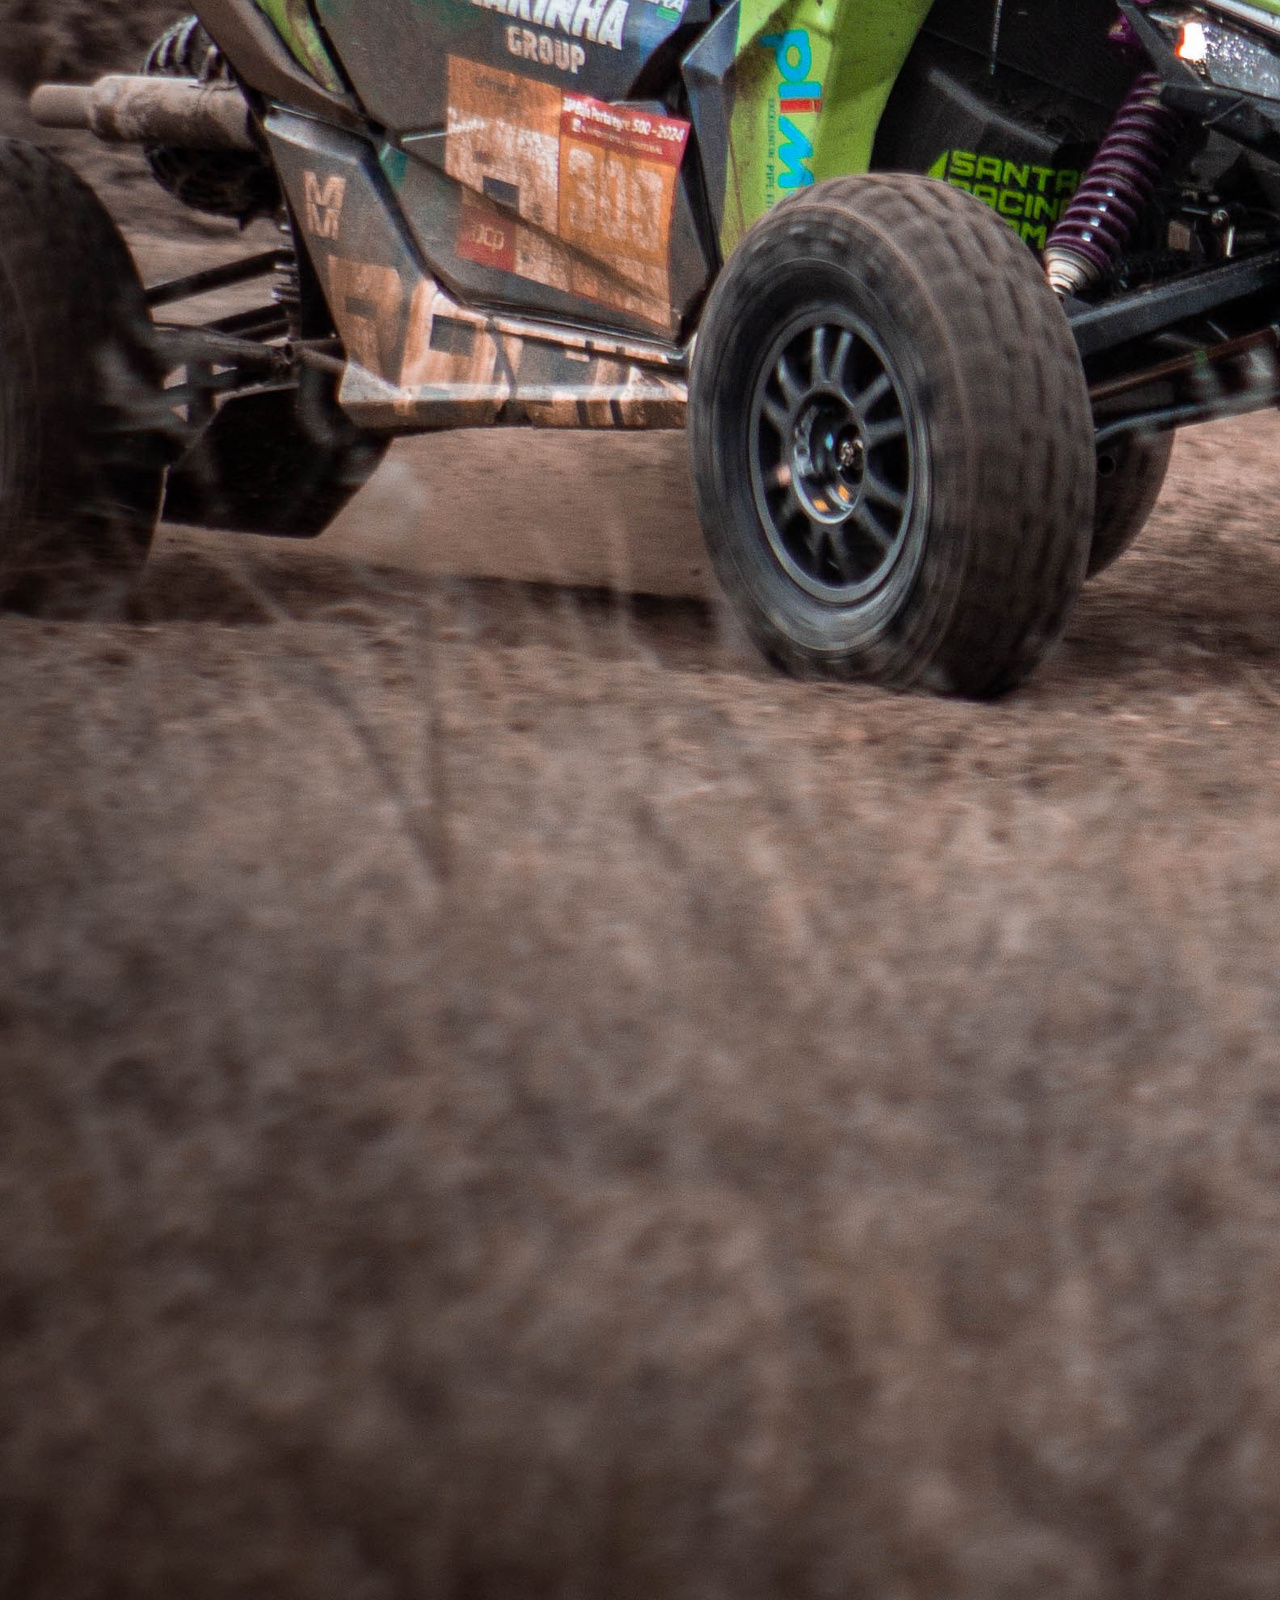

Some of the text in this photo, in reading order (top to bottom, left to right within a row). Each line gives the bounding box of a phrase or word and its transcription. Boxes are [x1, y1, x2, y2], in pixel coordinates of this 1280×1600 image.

[507, 25, 586, 74] GROUP
[759, 28, 823, 198] plim
[950, 150, 1085, 193] SANTA
